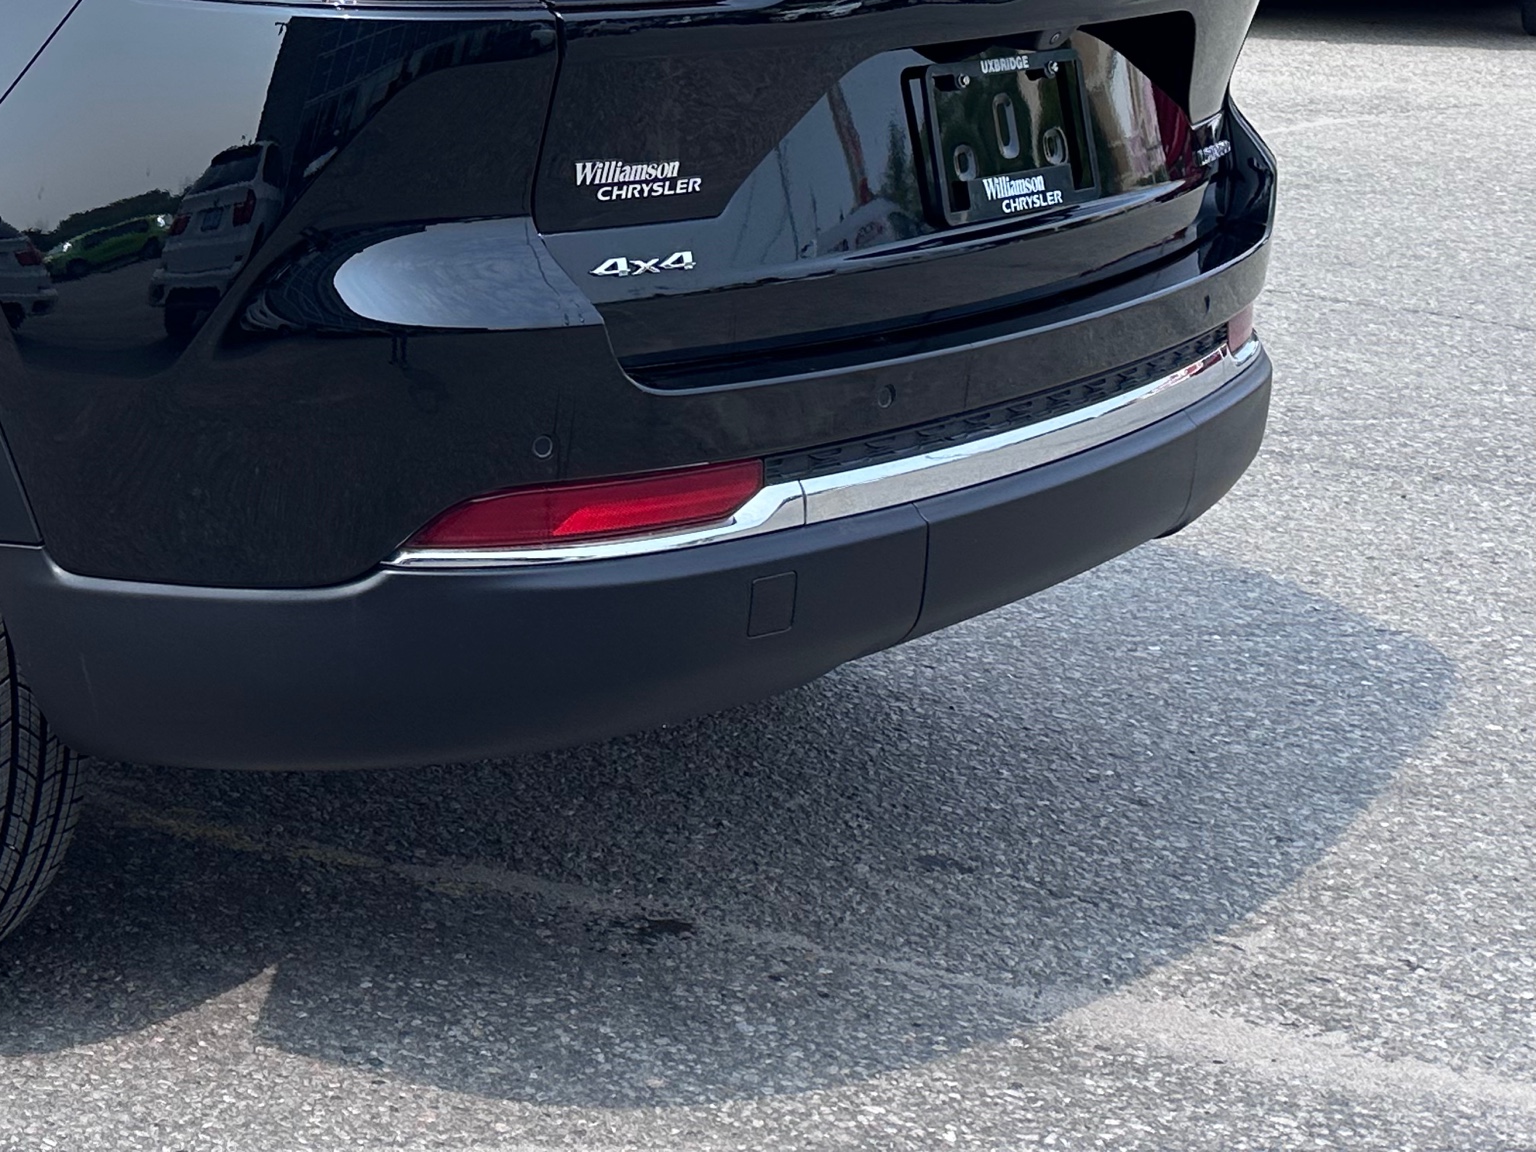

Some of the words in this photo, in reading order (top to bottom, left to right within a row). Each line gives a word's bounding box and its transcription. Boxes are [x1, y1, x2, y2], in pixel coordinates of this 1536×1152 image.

[980, 55, 1030, 74] UXBRIDGE
[575, 161, 680, 186] Williamson
[597, 177, 702, 201] CHRYSLER
[982, 175, 1045, 201] Williamson
[1001, 190, 1063, 214] CHRYSLER
[589, 251, 697, 276] 4x4
